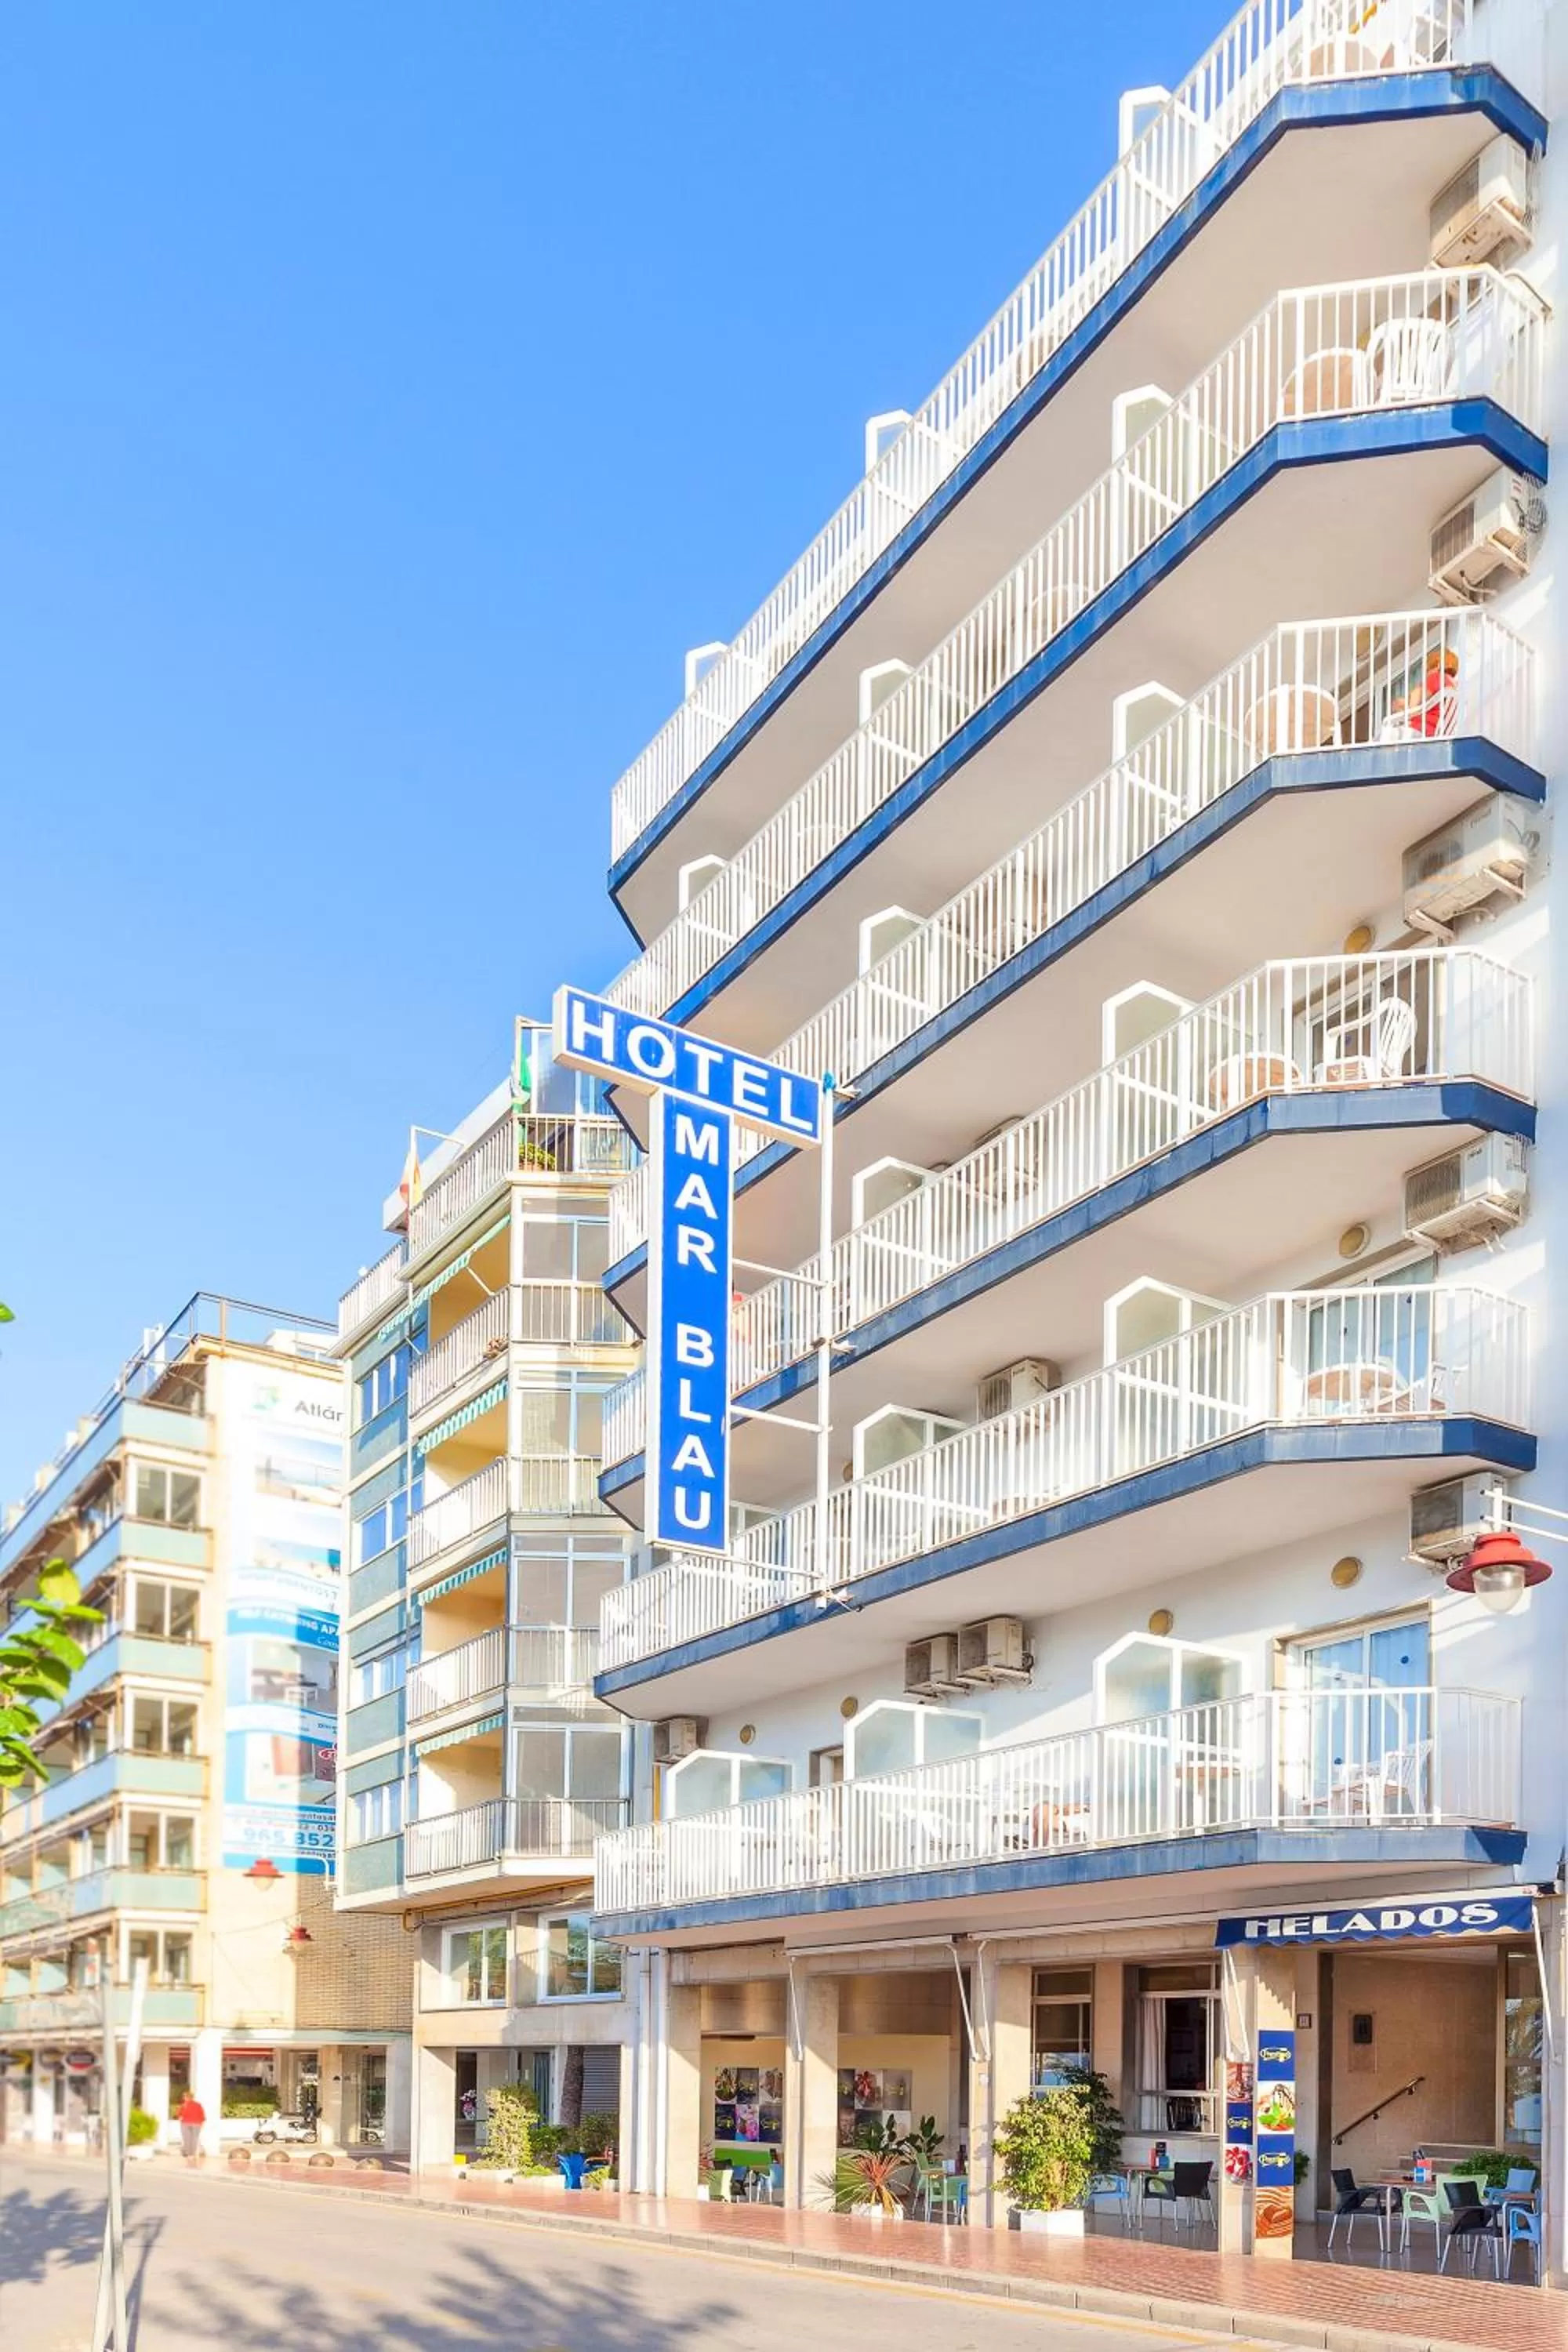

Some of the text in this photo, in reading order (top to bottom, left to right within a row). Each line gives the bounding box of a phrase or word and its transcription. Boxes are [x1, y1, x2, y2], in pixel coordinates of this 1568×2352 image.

[572, 1000, 813, 1131] HOTEL
[671, 1114, 719, 1530] MAR BLAU
[1245, 1903, 1498, 1938] HELADOS
